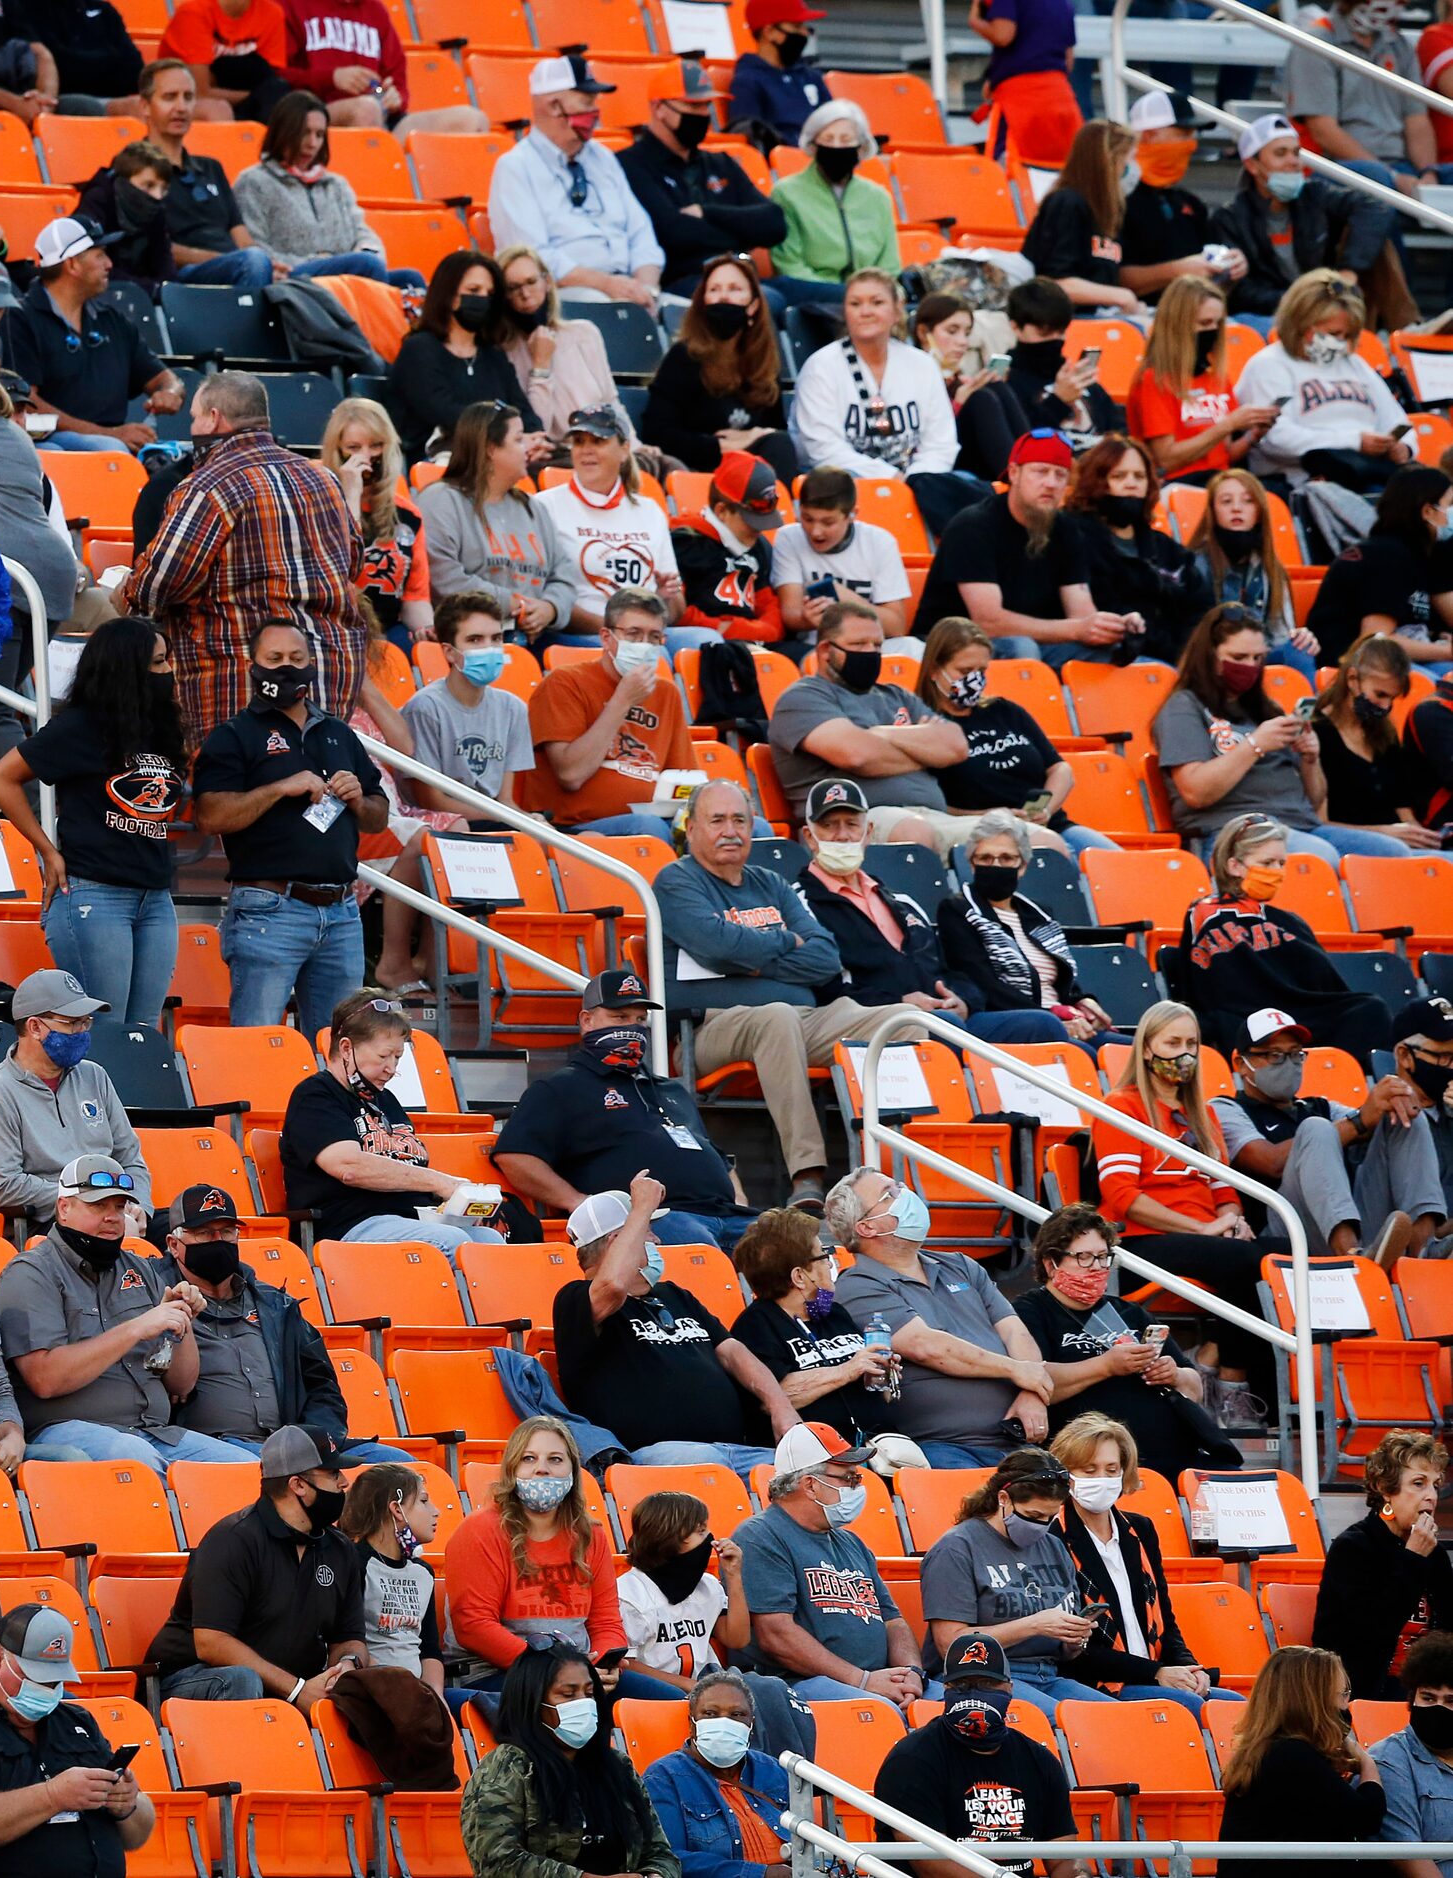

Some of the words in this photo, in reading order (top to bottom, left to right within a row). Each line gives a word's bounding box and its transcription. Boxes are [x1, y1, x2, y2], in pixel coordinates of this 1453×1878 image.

[845, 401, 919, 437] ADO
[262, 681, 279, 698] 23
[625, 705, 659, 730] EDO
[968, 731, 1031, 757] earcats
[472, 743, 503, 762] Rock
[106, 810, 167, 840] FOOTBA
[1189, 921, 1296, 970] BEARAT
[1267, 1012, 1283, 1025] T
[270, 1038, 281, 1046] 17
[199, 1140, 211, 1149] 15
[267, 1250, 279, 1259] 14
[407, 1253, 420, 1263] 15
[550, 1255, 564, 1264] 16
[340, 1362, 353, 1372] 13
[118, 1472, 131, 1483] 10
[1211, 1486, 1236, 1494] LEASE
[1245, 1509, 1267, 1517] THIS
[1239, 1532, 1258, 1541] ROW
[317, 1565, 333, 1584] SIG
[387, 1578, 417, 1587] LEADER
[807, 1572, 861, 1600] LEGEN
[655, 1619, 706, 1643] ALEDO
[675, 1643, 693, 1680] 1
[860, 1712, 872, 1722] 12
[1154, 1712, 1167, 1722] 14
[972, 1785, 1012, 1802] LEASE
[985, 1799, 1026, 1813] YOUR
[968, 1811, 1024, 1825] DTANCE
